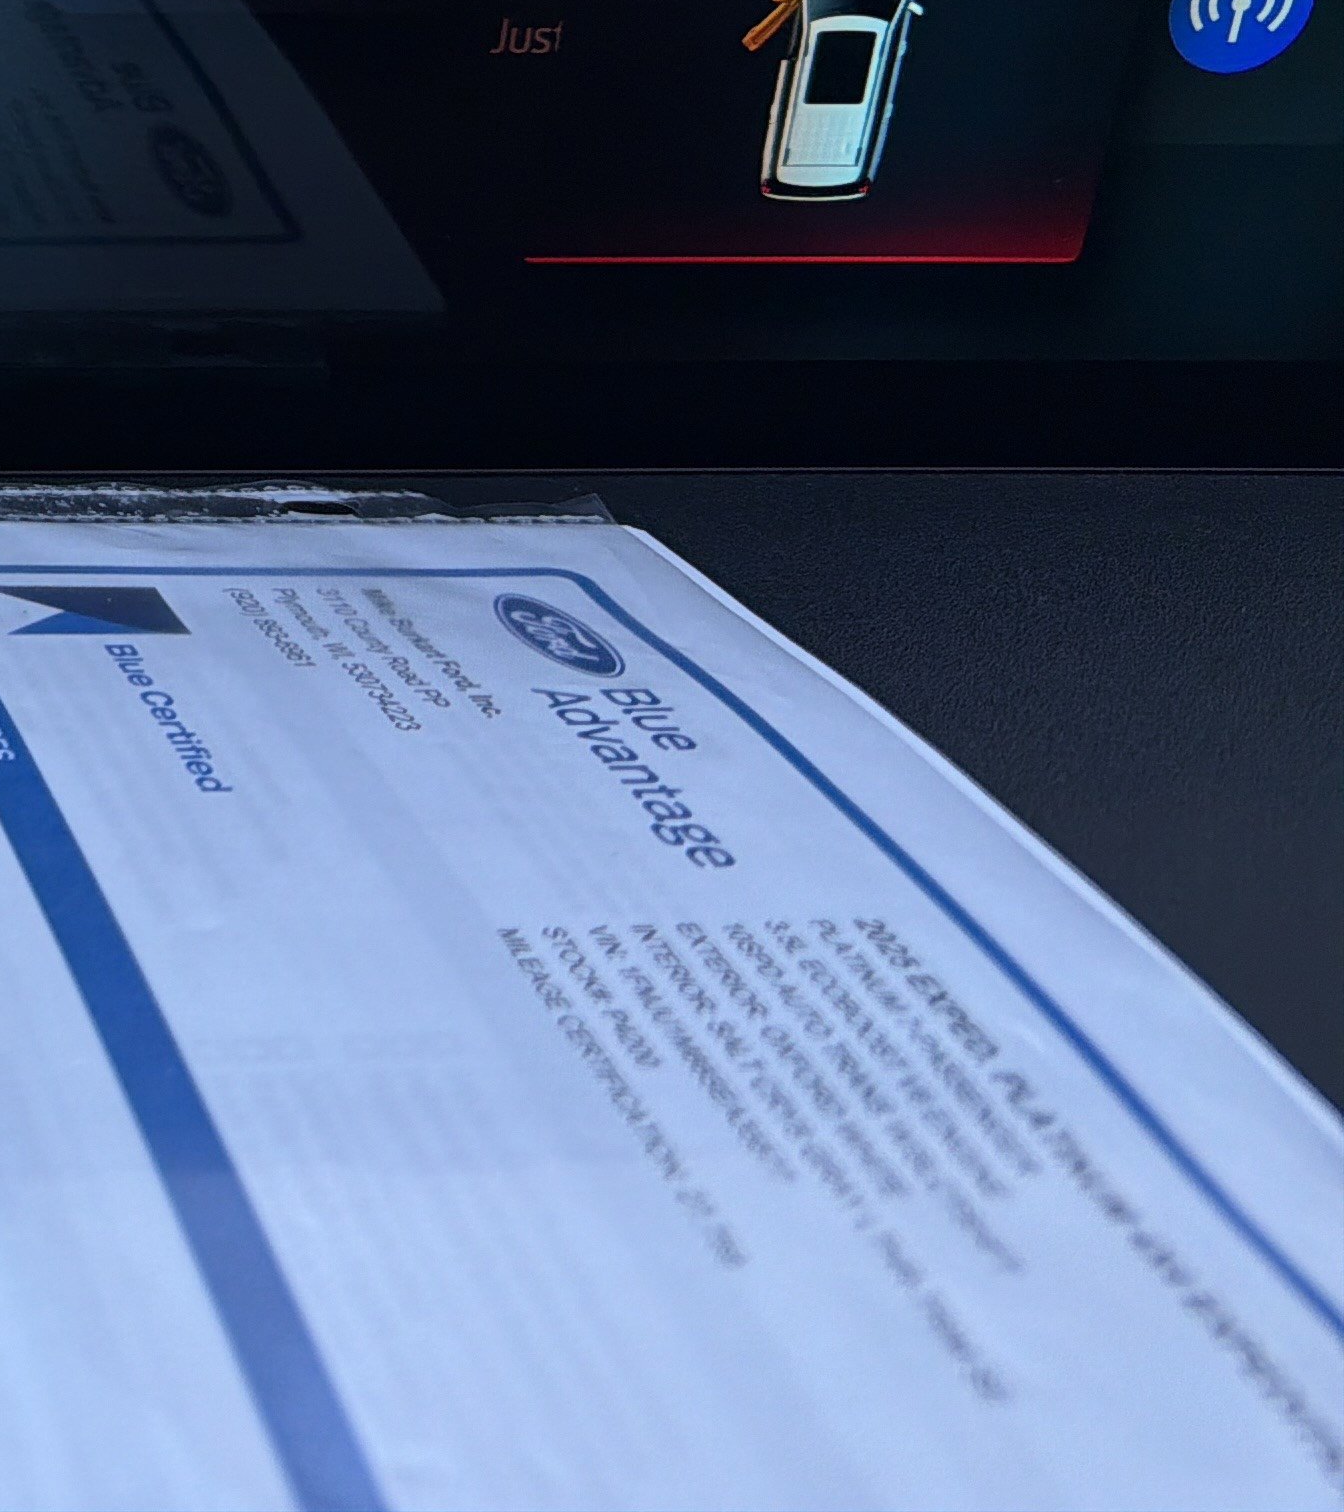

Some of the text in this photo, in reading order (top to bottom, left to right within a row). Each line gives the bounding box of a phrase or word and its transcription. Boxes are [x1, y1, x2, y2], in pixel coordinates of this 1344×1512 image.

[343, 617, 394, 655] County
[381, 656, 431, 686] Road
[412, 688, 452, 708] PP
[104, 644, 232, 793] Blue Certified
[467, 694, 504, 719] Inc.
[600, 688, 700, 751] Blue
[533, 688, 737, 867] Advantage
[497, 928, 571, 1009] MILEAGE
